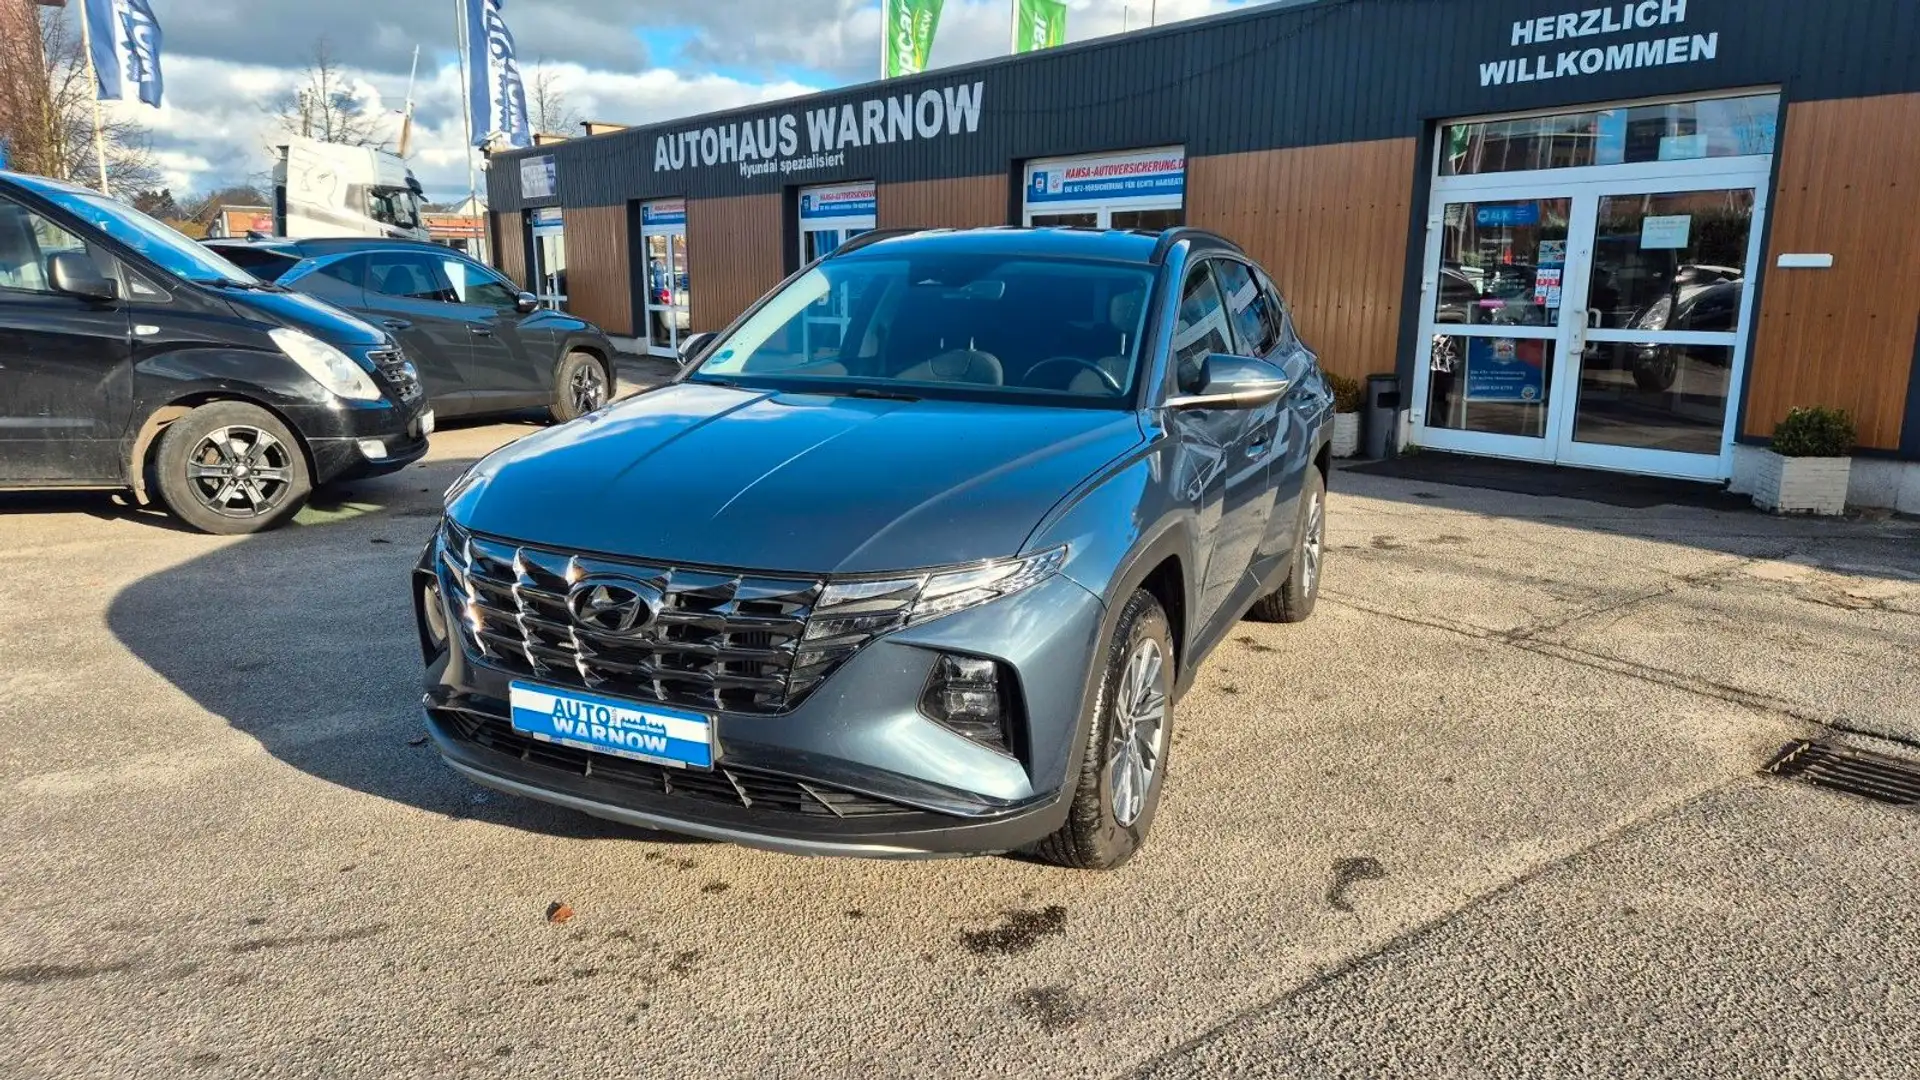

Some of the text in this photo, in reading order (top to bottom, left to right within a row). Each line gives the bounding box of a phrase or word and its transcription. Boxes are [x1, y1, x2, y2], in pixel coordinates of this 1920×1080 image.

[1510, 0, 1688, 46] HERZLICH
[1479, 32, 1719, 87] WILLKOMMEN
[653, 81, 984, 172] AUTOHAUS WARNOW
[740, 151, 845, 178] Hyundai spezialisiert
[552, 698, 610, 726] AUTO
[552, 716, 668, 753] WARNOW
